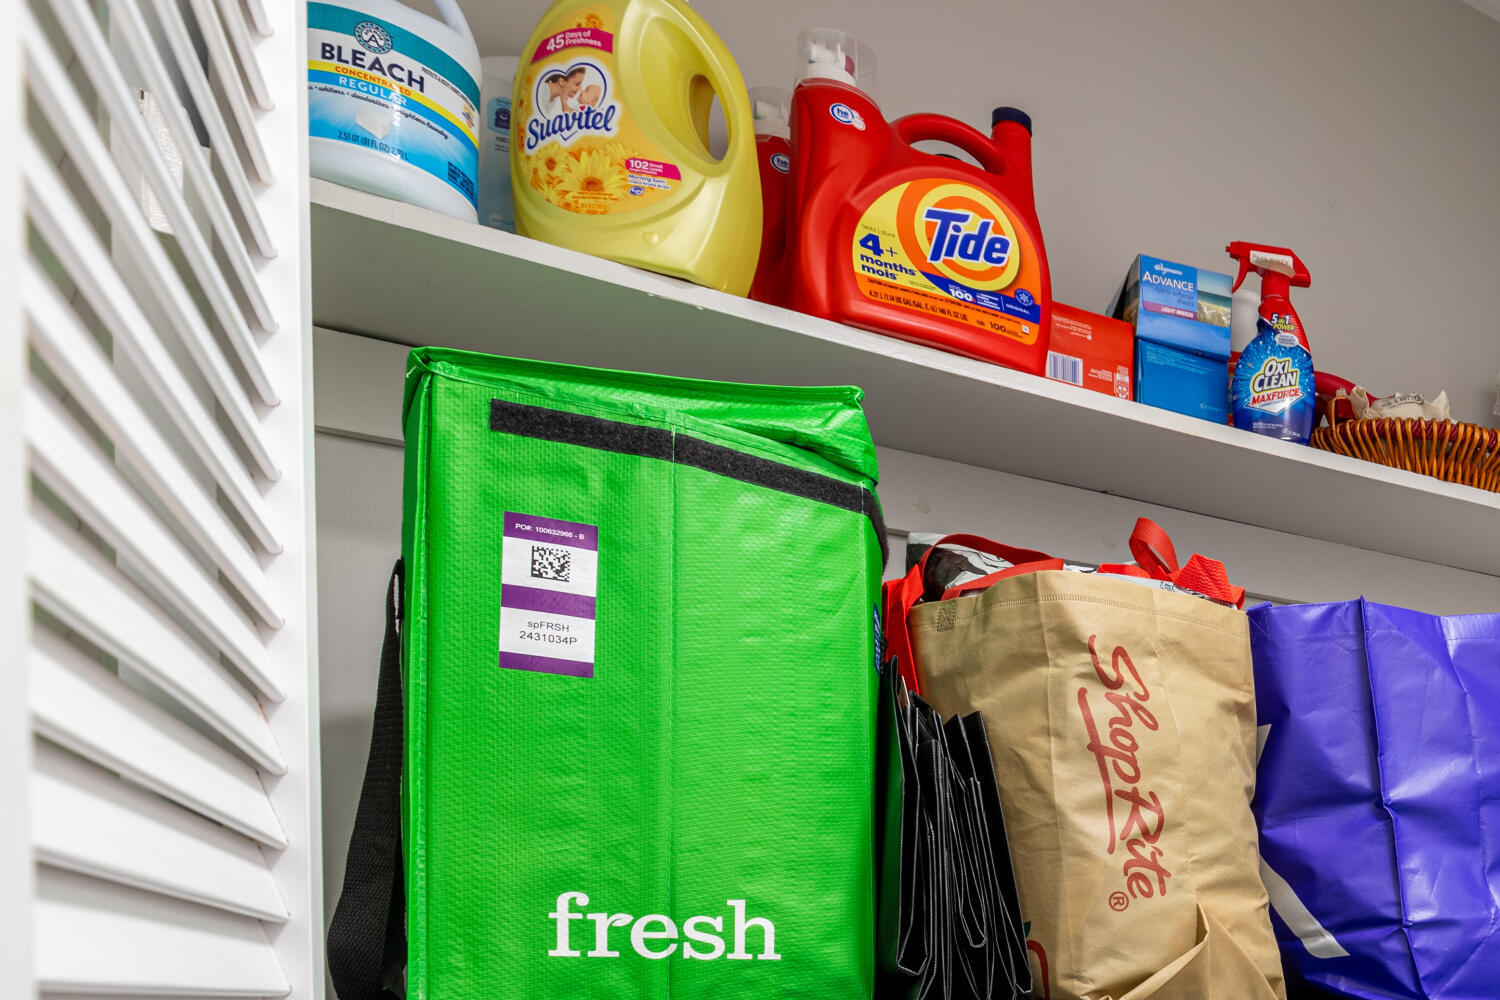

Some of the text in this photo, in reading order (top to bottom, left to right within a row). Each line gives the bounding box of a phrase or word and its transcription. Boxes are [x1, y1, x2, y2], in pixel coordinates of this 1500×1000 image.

[583, 30, 592, 38] of
[546, 34, 564, 52] 45
[565, 38, 602, 48] Freshness
[320, 42, 425, 93] BLEACH
[335, 66, 412, 97] CONCENTRAED
[836, 108, 849, 118] he
[526, 104, 616, 150] Suavitel
[629, 160, 649, 170] 102
[859, 232, 898, 258] 4+
[924, 208, 1010, 265] Tide
[860, 254, 916, 277] months
[861, 264, 898, 281] mois
[1142, 272, 1194, 292] ADVANCE
[949, 288, 973, 302] 100
[1162, 306, 1194, 318] LIGHT BREEZE
[1272, 313, 1280, 324] 5
[990, 322, 1007, 332] 100
[1273, 322, 1294, 331] POWER
[1265, 358, 1290, 377] OXI
[1254, 371, 1298, 392] CLEAN
[1252, 388, 1300, 406] MAXFORCE
[515, 523, 533, 532] PO#:
[527, 620, 570, 632] spFRSH
[519, 630, 578, 646] 2431034P
[548, 890, 782, 962] fresh
